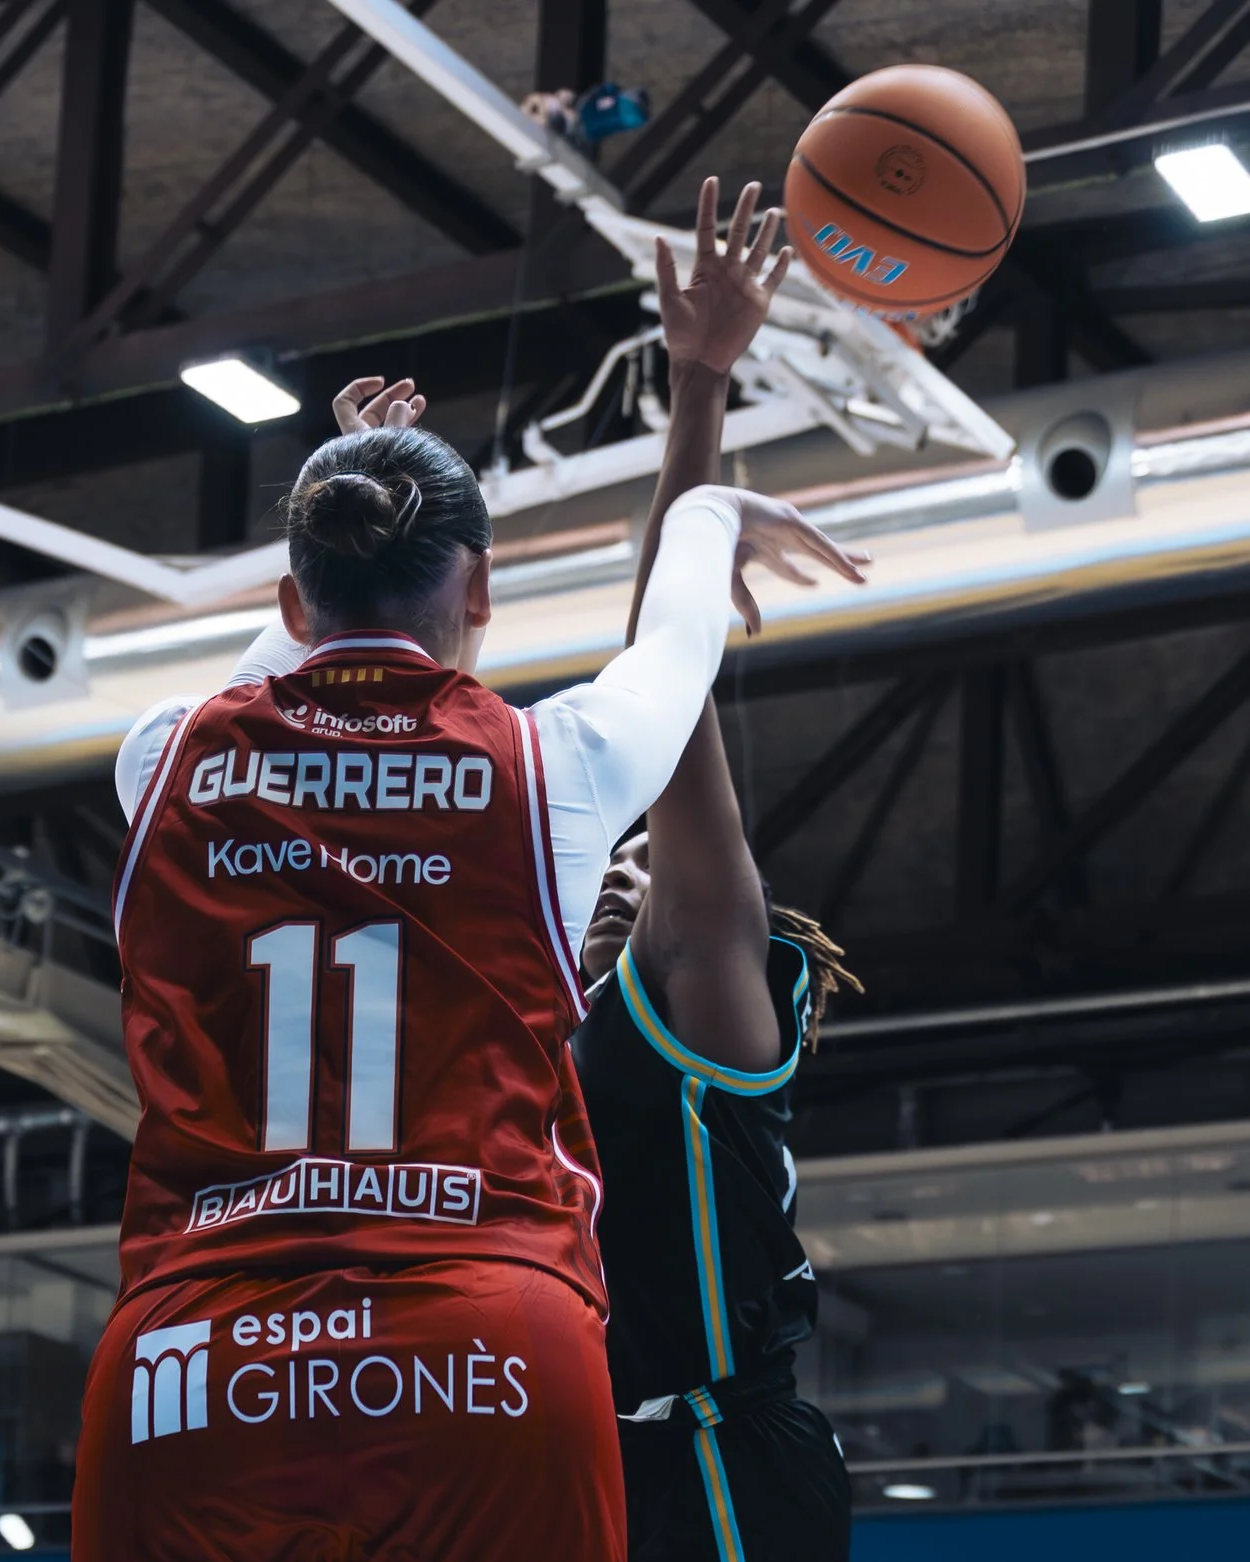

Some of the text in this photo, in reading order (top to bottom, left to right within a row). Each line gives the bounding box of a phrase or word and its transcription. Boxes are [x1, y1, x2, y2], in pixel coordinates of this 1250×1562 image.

[812, 222, 910, 286] EVO
[313, 707, 417, 734] infosoft
[187, 748, 494, 811] GUERRERO
[207, 838, 451, 885] Kave Home
[249, 921, 402, 1153] 11
[196, 1166, 471, 1228] BAUHAUS
[232, 1297, 372, 1351] espai
[226, 1338, 530, 1424] GIRONÈS
